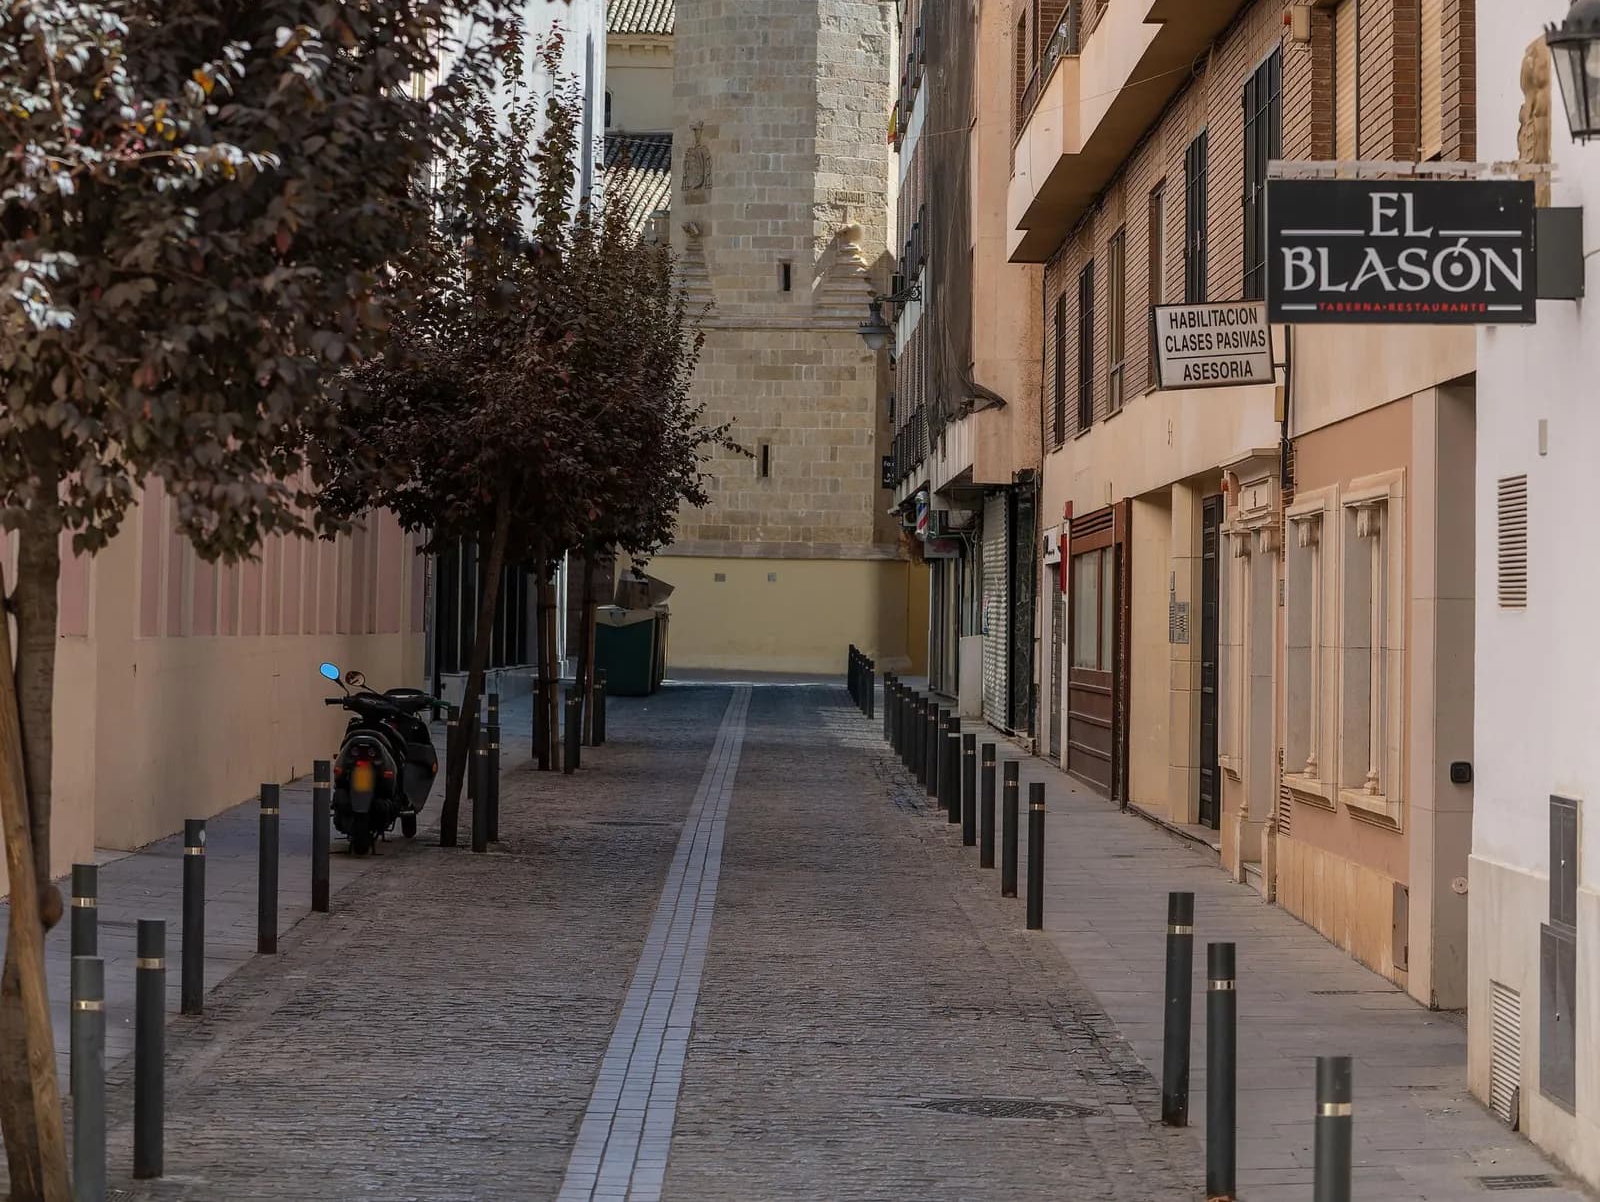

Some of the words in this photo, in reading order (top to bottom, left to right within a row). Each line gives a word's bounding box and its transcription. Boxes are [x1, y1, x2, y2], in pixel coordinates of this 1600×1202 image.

[1368, 192, 1434, 238] EL
[1280, 238, 1523, 293] BLASÓN
[1169, 307, 1258, 330] HABILITACION
[1165, 333, 1213, 353] CLASES
[1216, 329, 1266, 350] PASIVAS
[1183, 360, 1253, 382] ASESORIA
